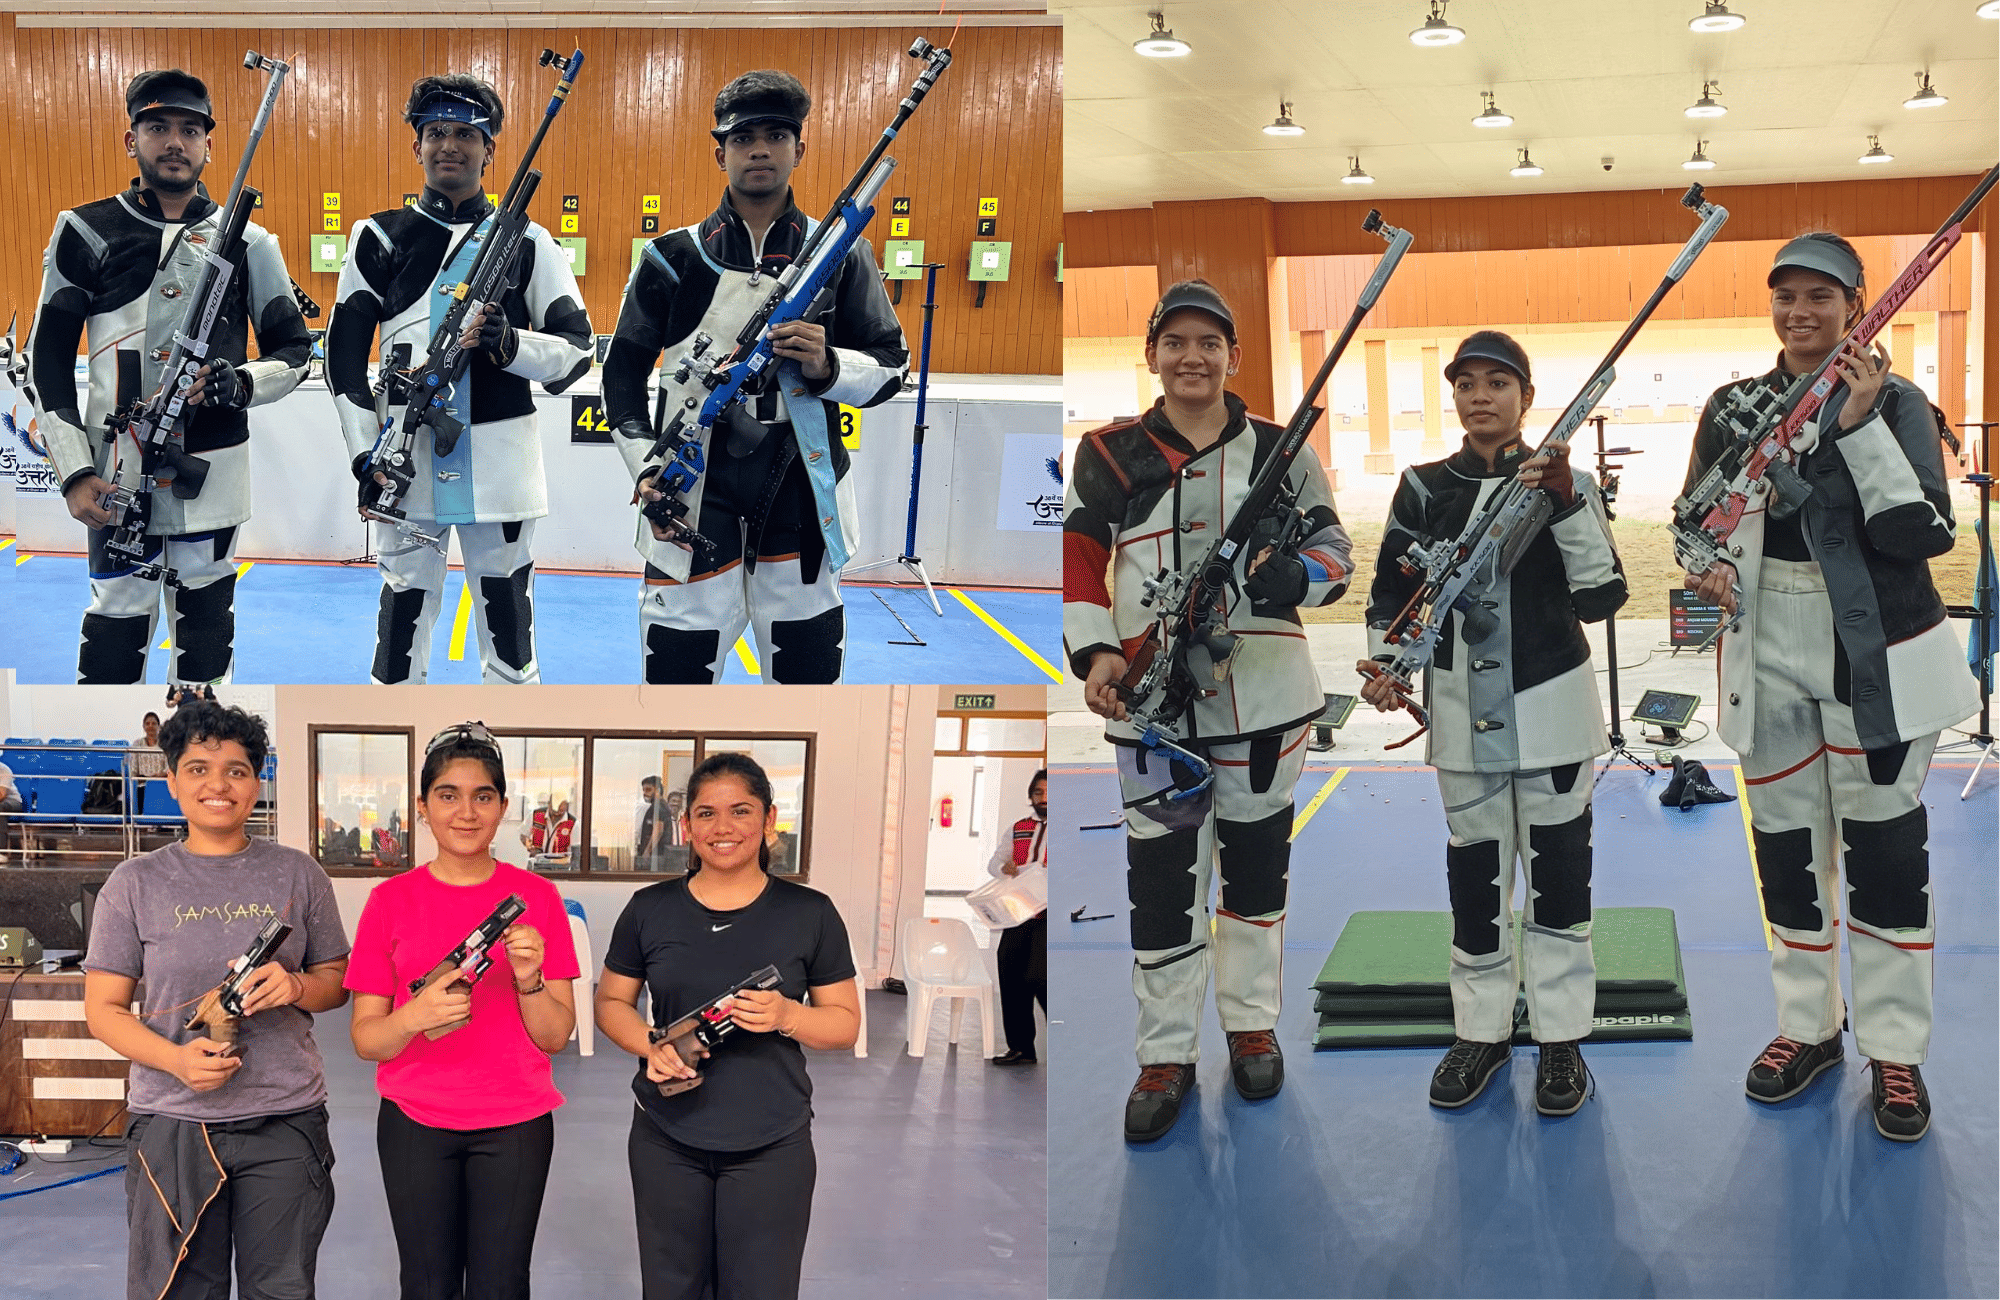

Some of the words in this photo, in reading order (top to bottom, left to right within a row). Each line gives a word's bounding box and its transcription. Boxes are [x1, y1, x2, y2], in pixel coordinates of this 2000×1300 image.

[326, 196, 338, 206] 39
[564, 198, 577, 209] 42
[645, 200, 658, 209] 43
[894, 201, 908, 211] 44
[982, 202, 995, 212] 45
[326, 217, 339, 227] R1
[565, 219, 574, 229] C
[645, 219, 655, 230] D
[896, 222, 904, 232] E
[982, 222, 990, 233] F
[203, 274, 226, 331] monotec
[1862, 264, 1924, 340] WALTHER
[958, 696, 985, 707] EXIT
[175, 902, 277, 928] SAMSARA
